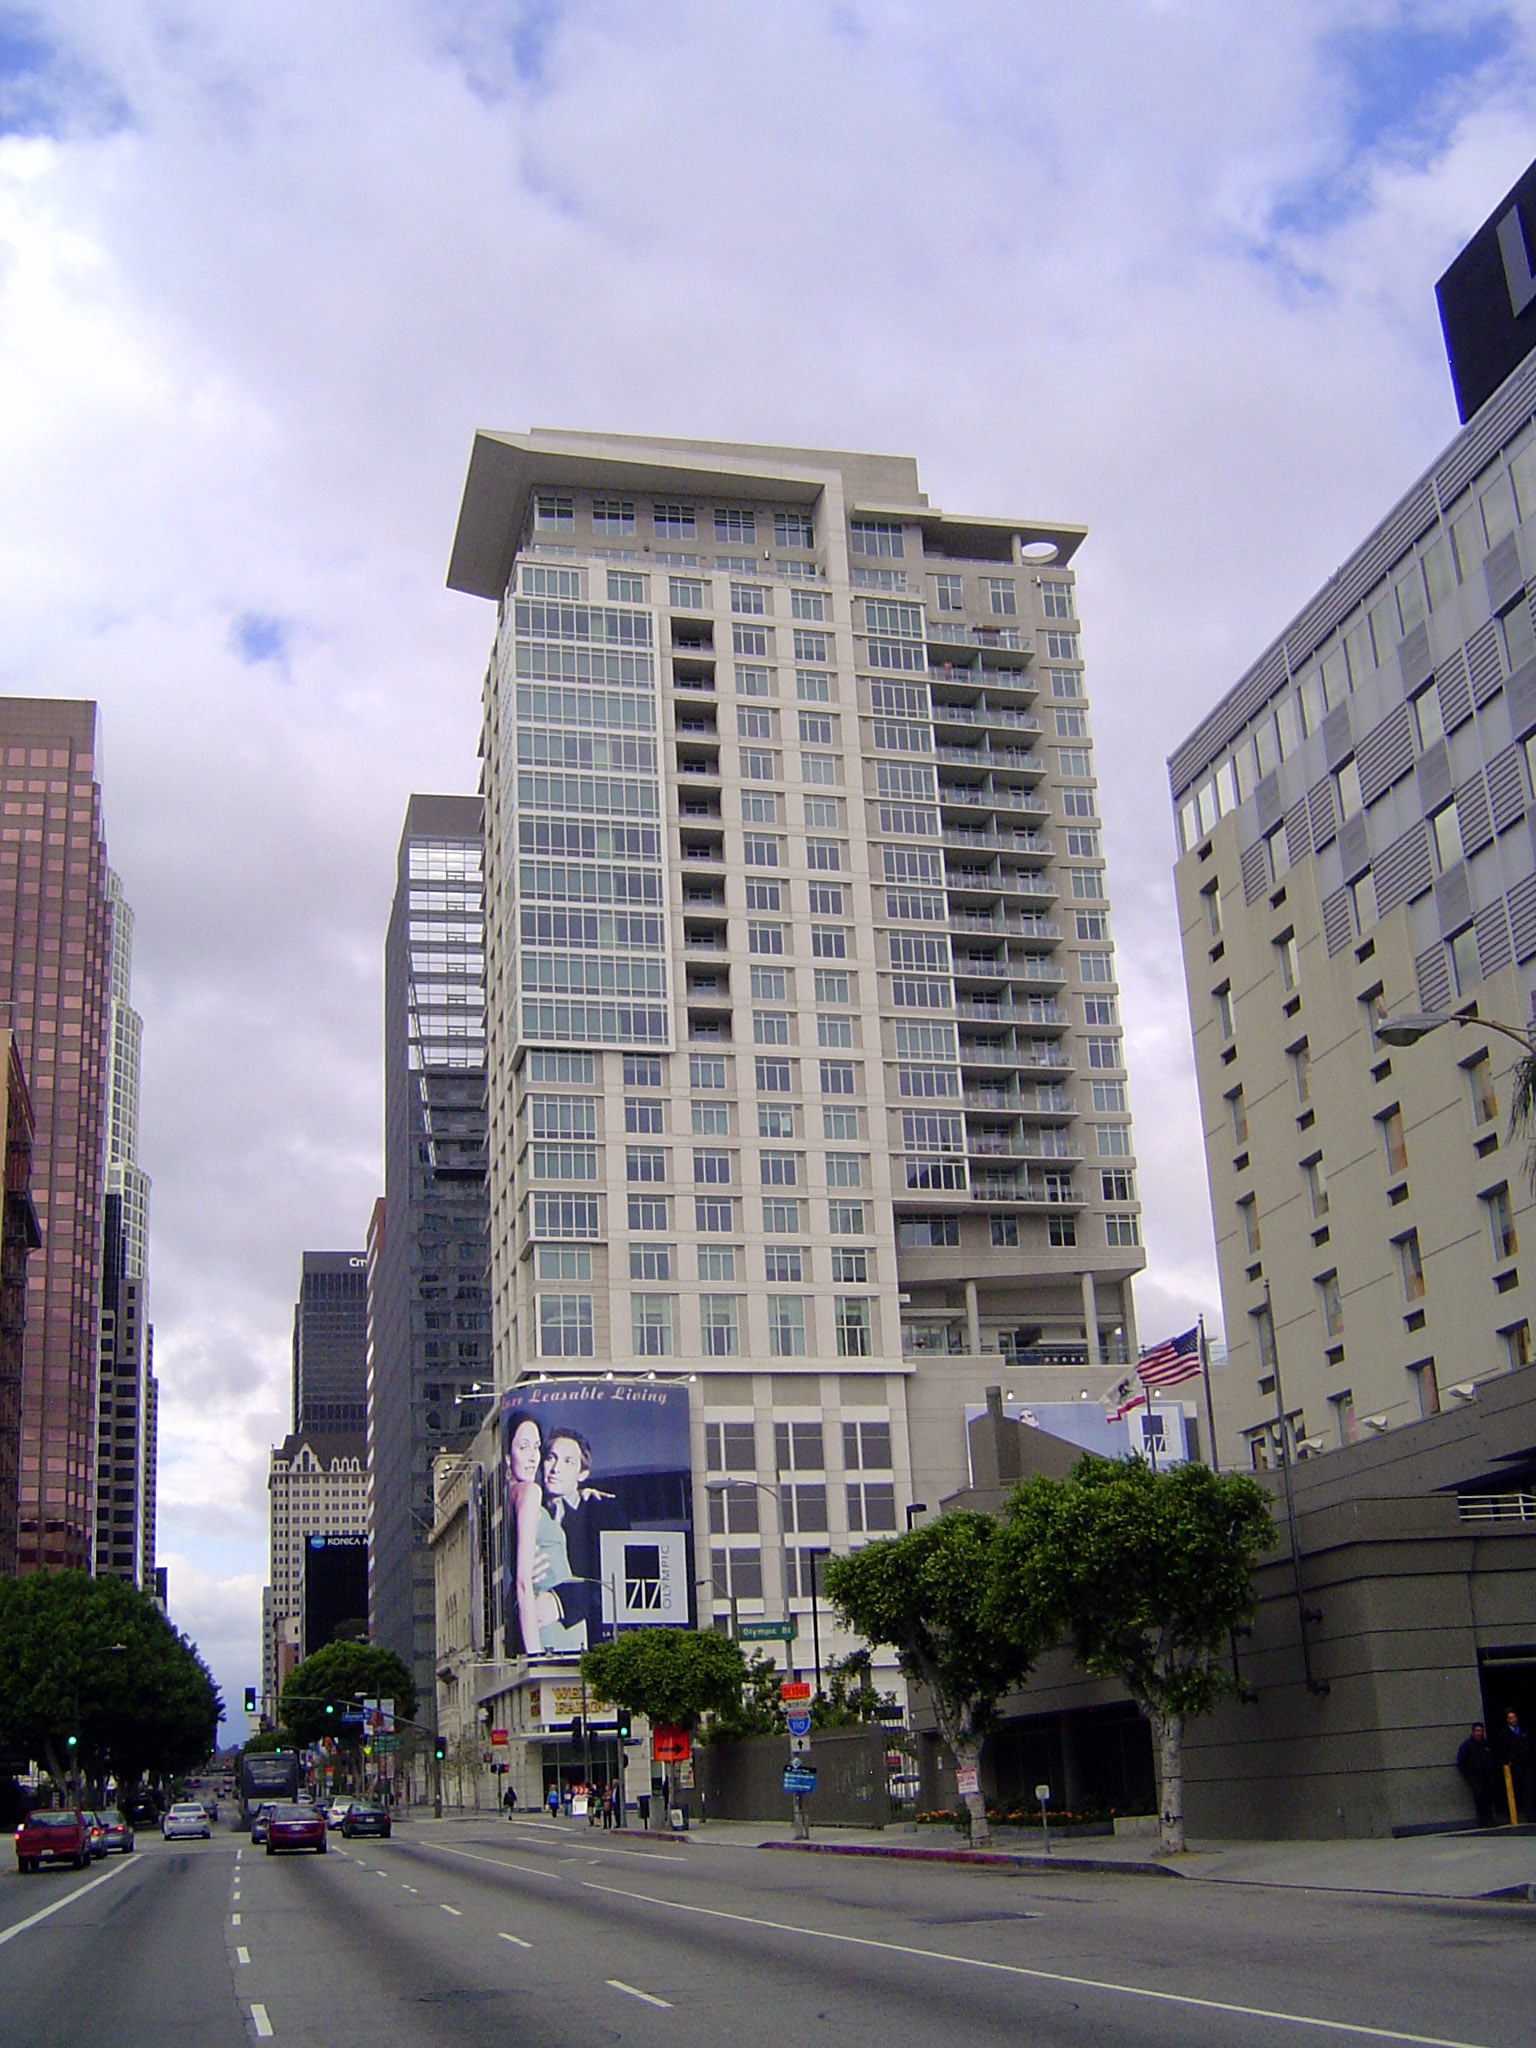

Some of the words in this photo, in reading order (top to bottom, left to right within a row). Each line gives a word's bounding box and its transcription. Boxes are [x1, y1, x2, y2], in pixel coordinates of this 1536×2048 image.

[528, 1386, 604, 1403] Leasable
[611, 1386, 667, 1406] Living
[328, 1537, 361, 1546] KONICA
[661, 1545, 672, 1610] OLYMPIC
[624, 1578, 662, 1610] 717
[743, 1627, 777, 1639] Olympic
[792, 1720, 805, 1730] 110
